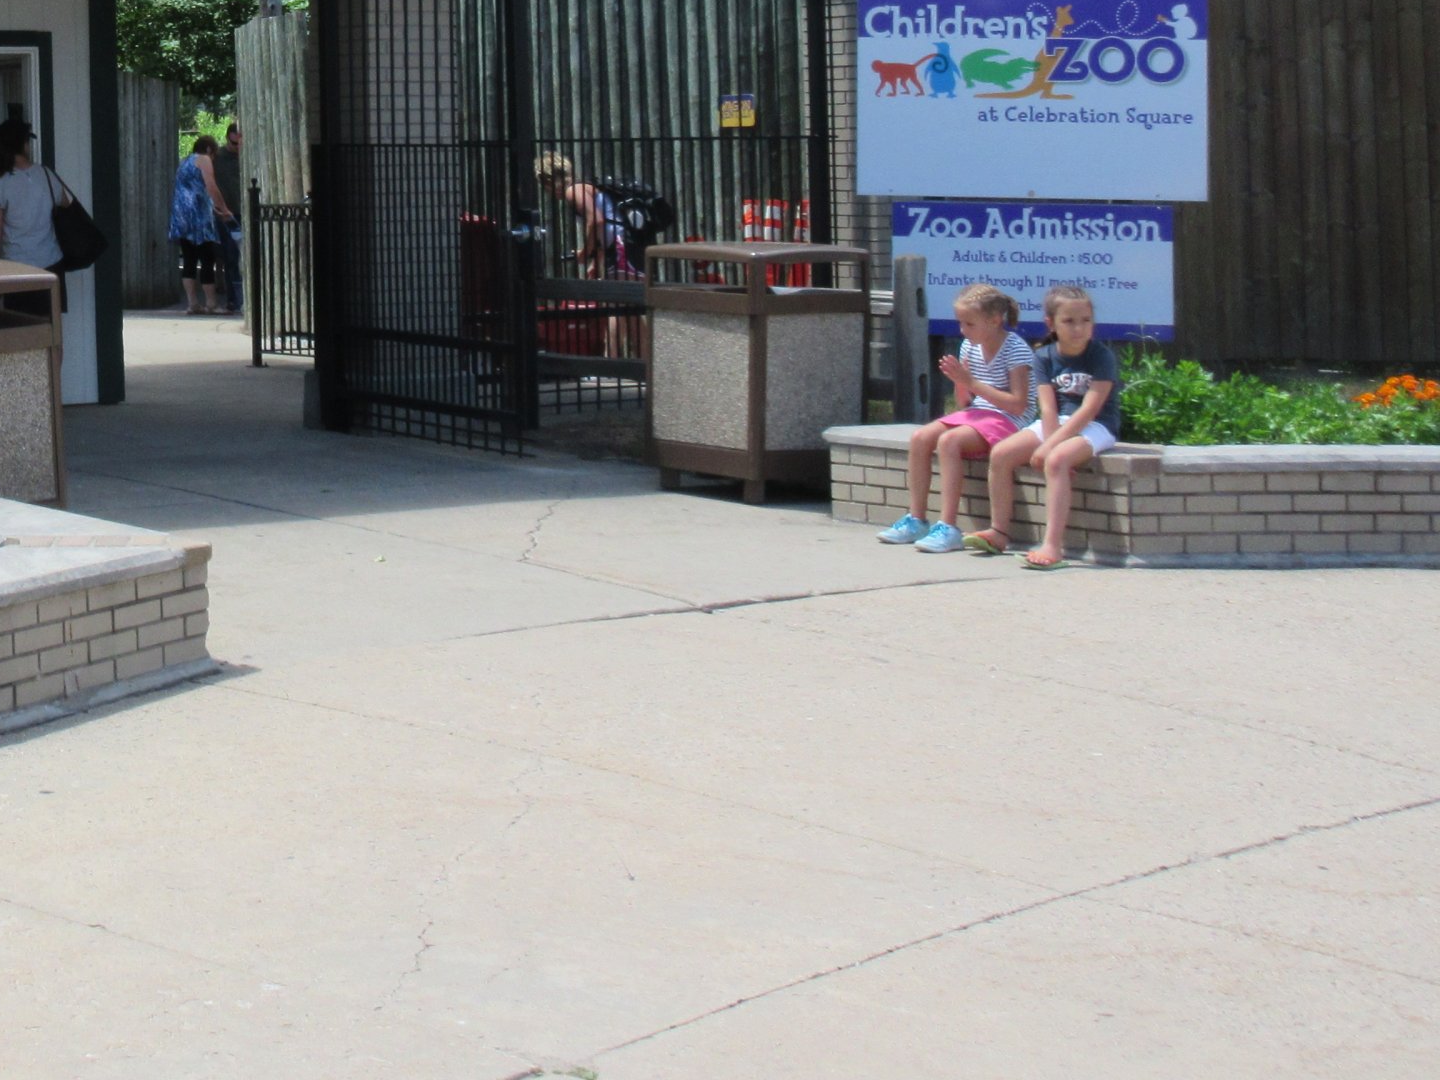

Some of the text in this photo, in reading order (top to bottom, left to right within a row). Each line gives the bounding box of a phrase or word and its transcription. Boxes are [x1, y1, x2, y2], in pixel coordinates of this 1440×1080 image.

[864, 4, 1048, 39] Children's
[1044, 36, 1185, 83] ZOO
[977, 106, 1194, 130] at Celebration Square
[908, 207, 1162, 241] Zoo Admission
[952, 250, 995, 263] Adults
[998, 251, 1008, 263] &
[1010, 251, 1067, 264] Children
[1078, 252, 1113, 265] $5.00
[1049, 276, 1098, 289] months
[1108, 277, 1139, 290] Free
